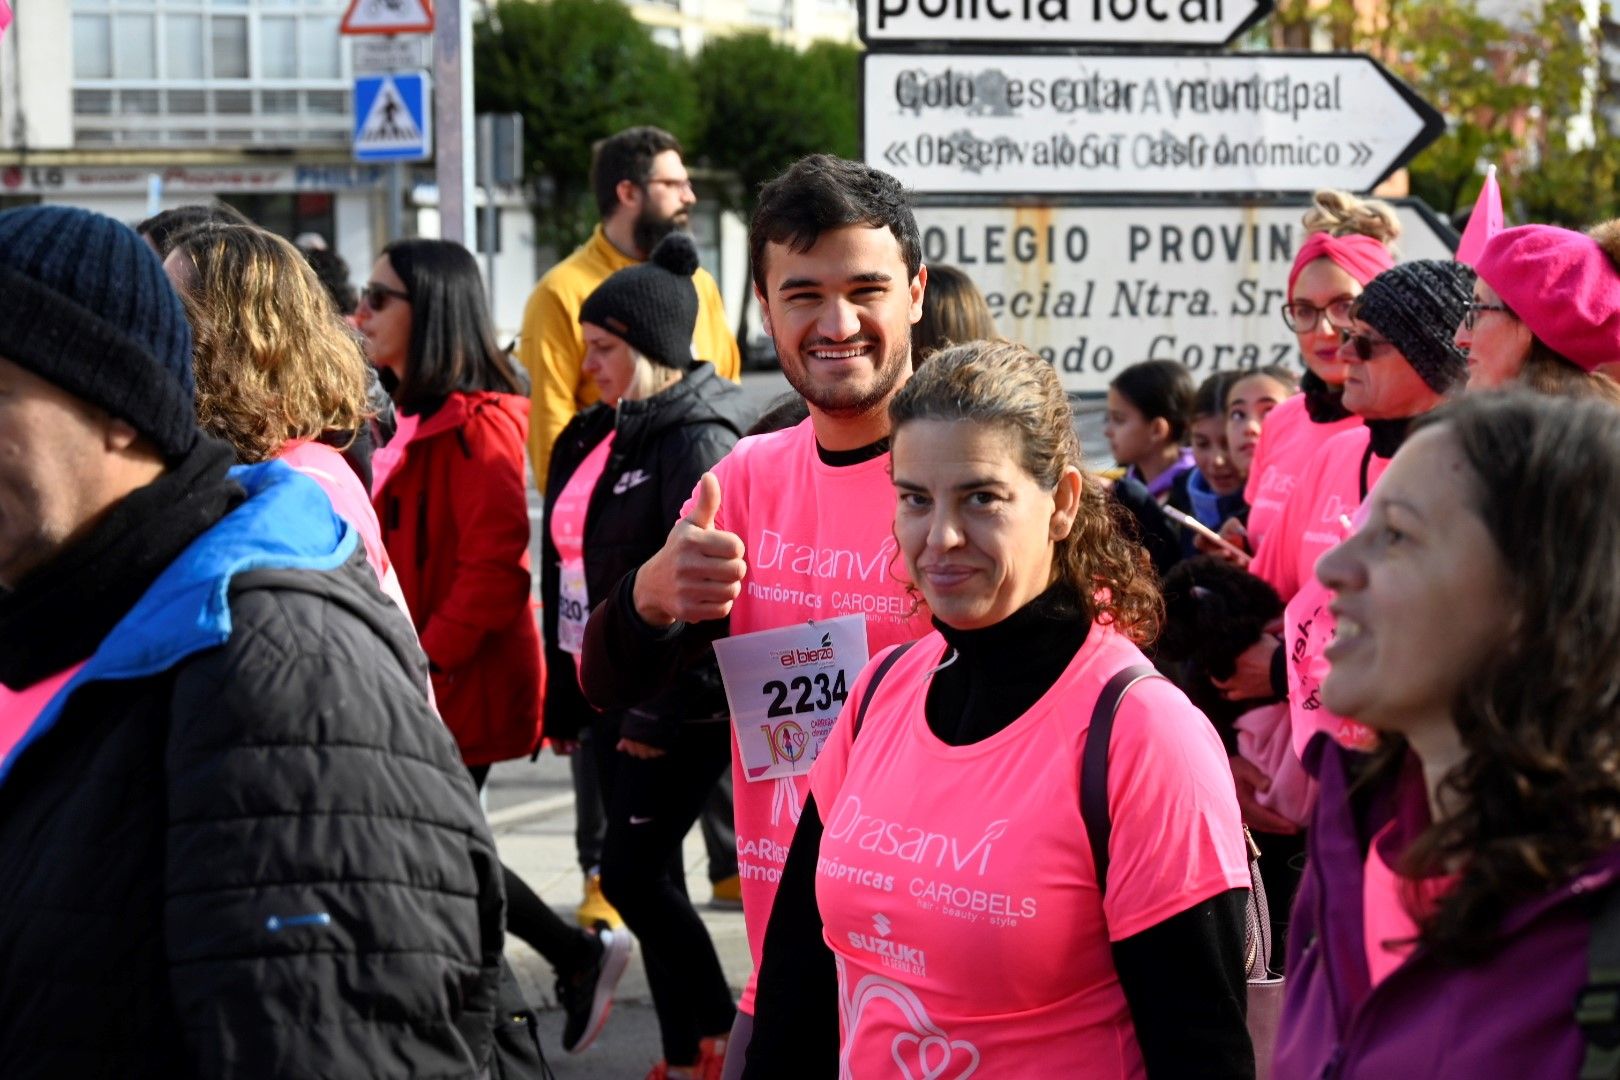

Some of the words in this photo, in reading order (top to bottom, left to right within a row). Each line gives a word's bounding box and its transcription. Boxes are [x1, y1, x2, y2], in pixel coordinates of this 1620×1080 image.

[923, 225, 1089, 264] OLEGIO
[1129, 224, 1293, 263] PROVIN
[986, 281, 1095, 319] ecial
[1230, 278, 1284, 317] Sr
[1039, 337, 1113, 373] ado
[1149, 334, 1306, 373] Coraz
[780, 650, 796, 666] el
[762, 669, 849, 719] 2234
[908, 877, 1037, 919] CAROBELS
[942, 906, 979, 923] beauty
[989, 916, 1018, 929] style
[847, 931, 926, 967] SUZUKI
